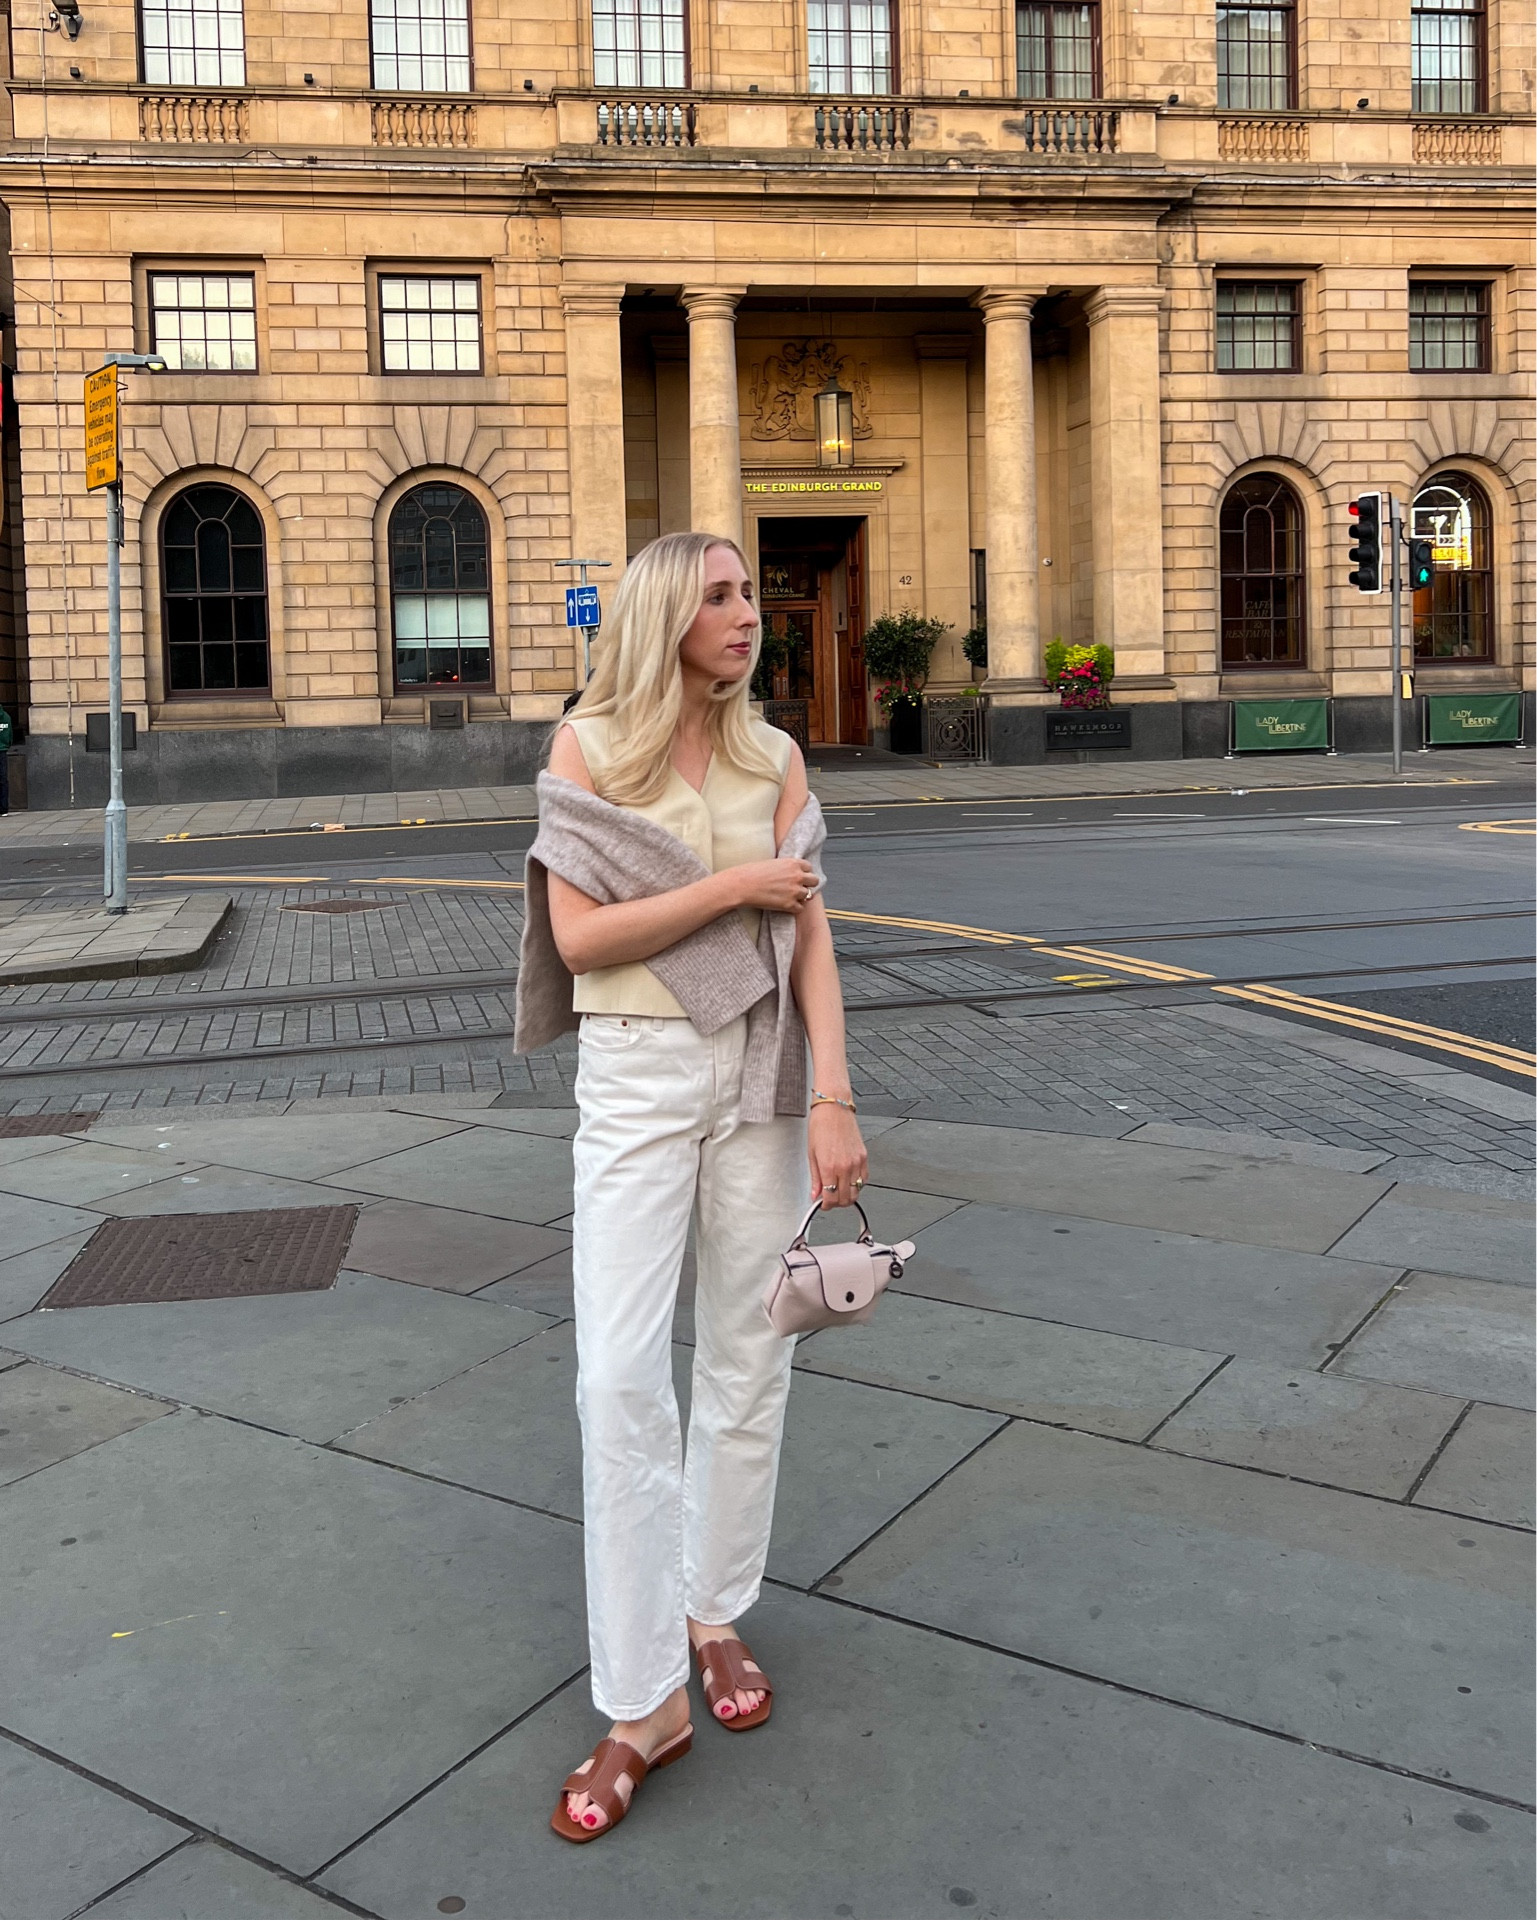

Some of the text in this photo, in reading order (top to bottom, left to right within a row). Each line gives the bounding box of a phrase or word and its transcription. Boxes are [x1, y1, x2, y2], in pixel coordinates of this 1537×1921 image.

[90, 372, 111, 393] CAUTION
[89, 395, 112, 413] Emergency
[88, 411, 114, 431] vehicles may
[94, 429, 114, 447] operating
[102, 445, 114, 460] traffic
[745, 482, 882, 493] THE EDINBURGH GRAND
[899, 575, 912, 585] 42
[1256, 716, 1279, 727] LADY
[1449, 710, 1472, 720] LADY
[1268, 723, 1307, 734] LIBERTINE
